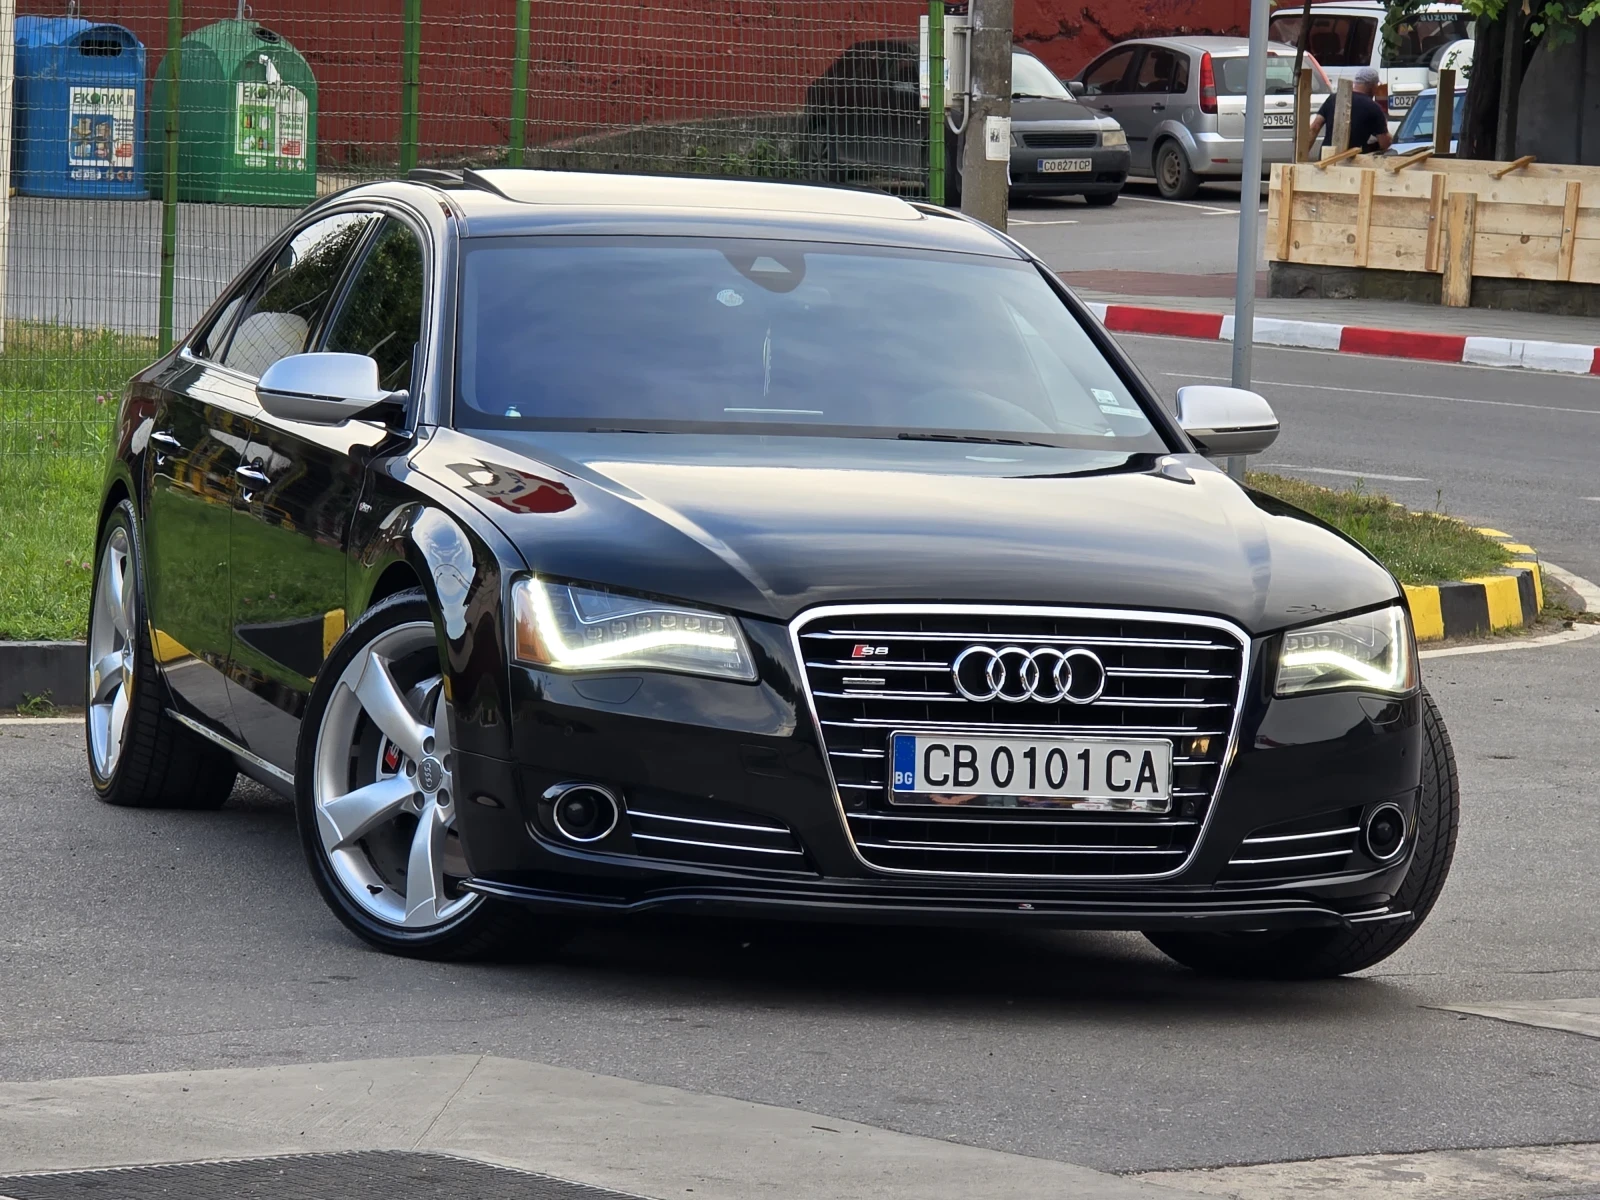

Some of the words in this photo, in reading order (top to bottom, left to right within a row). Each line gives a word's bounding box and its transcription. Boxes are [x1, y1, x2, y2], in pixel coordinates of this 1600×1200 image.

[1273, 115, 1294, 125] 9846
[860, 646, 889, 656] S8
[923, 744, 980, 788] CB
[990, 745, 1091, 791] 0101
[1105, 749, 1160, 793] CA
[895, 771, 913, 785] BG
